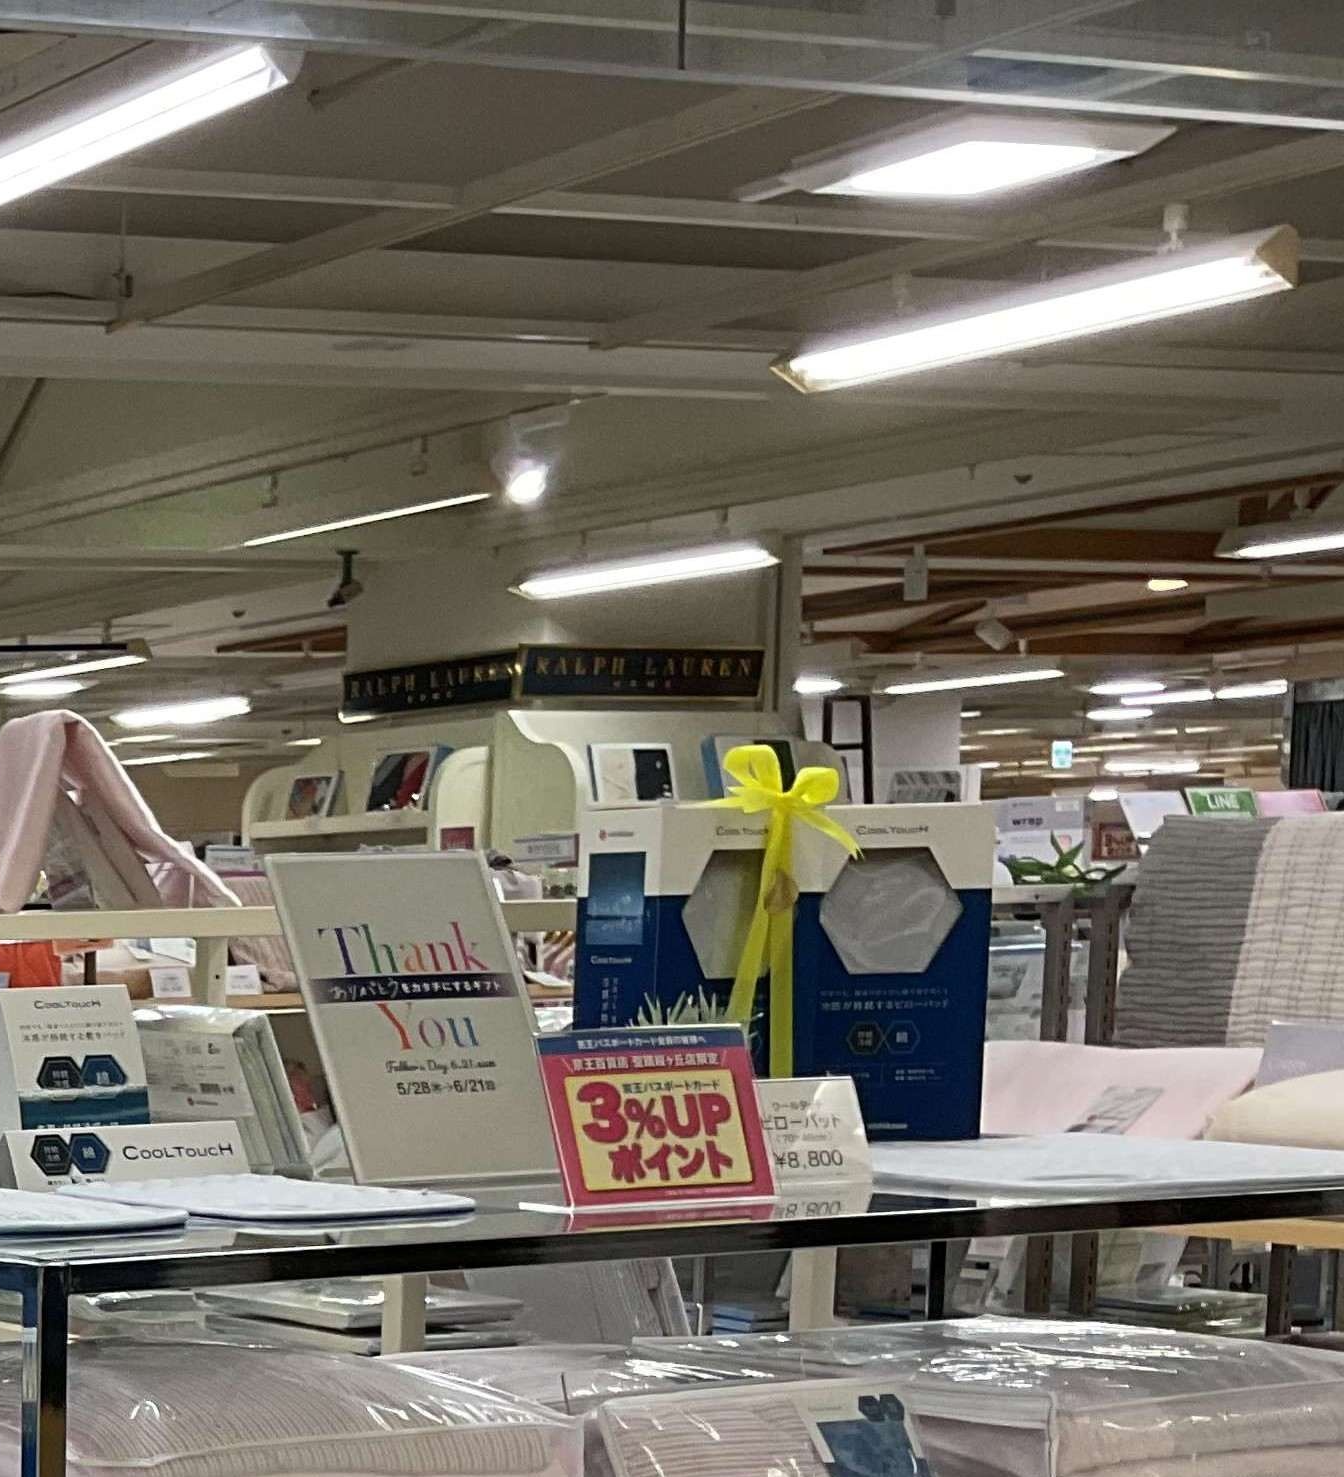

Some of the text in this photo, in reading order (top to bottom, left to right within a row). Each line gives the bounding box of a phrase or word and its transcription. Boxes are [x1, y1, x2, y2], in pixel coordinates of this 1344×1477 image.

[536, 656, 753, 678] RALPH LAUREN
[1206, 792, 1240, 810] LINE
[317, 921, 490, 976] Thank
[375, 1001, 480, 1051] You
[577, 1081, 733, 1145] 3%UP
[608, 1140, 733, 1184] ポイント
[774, 1149, 844, 1169] ¥8,800
